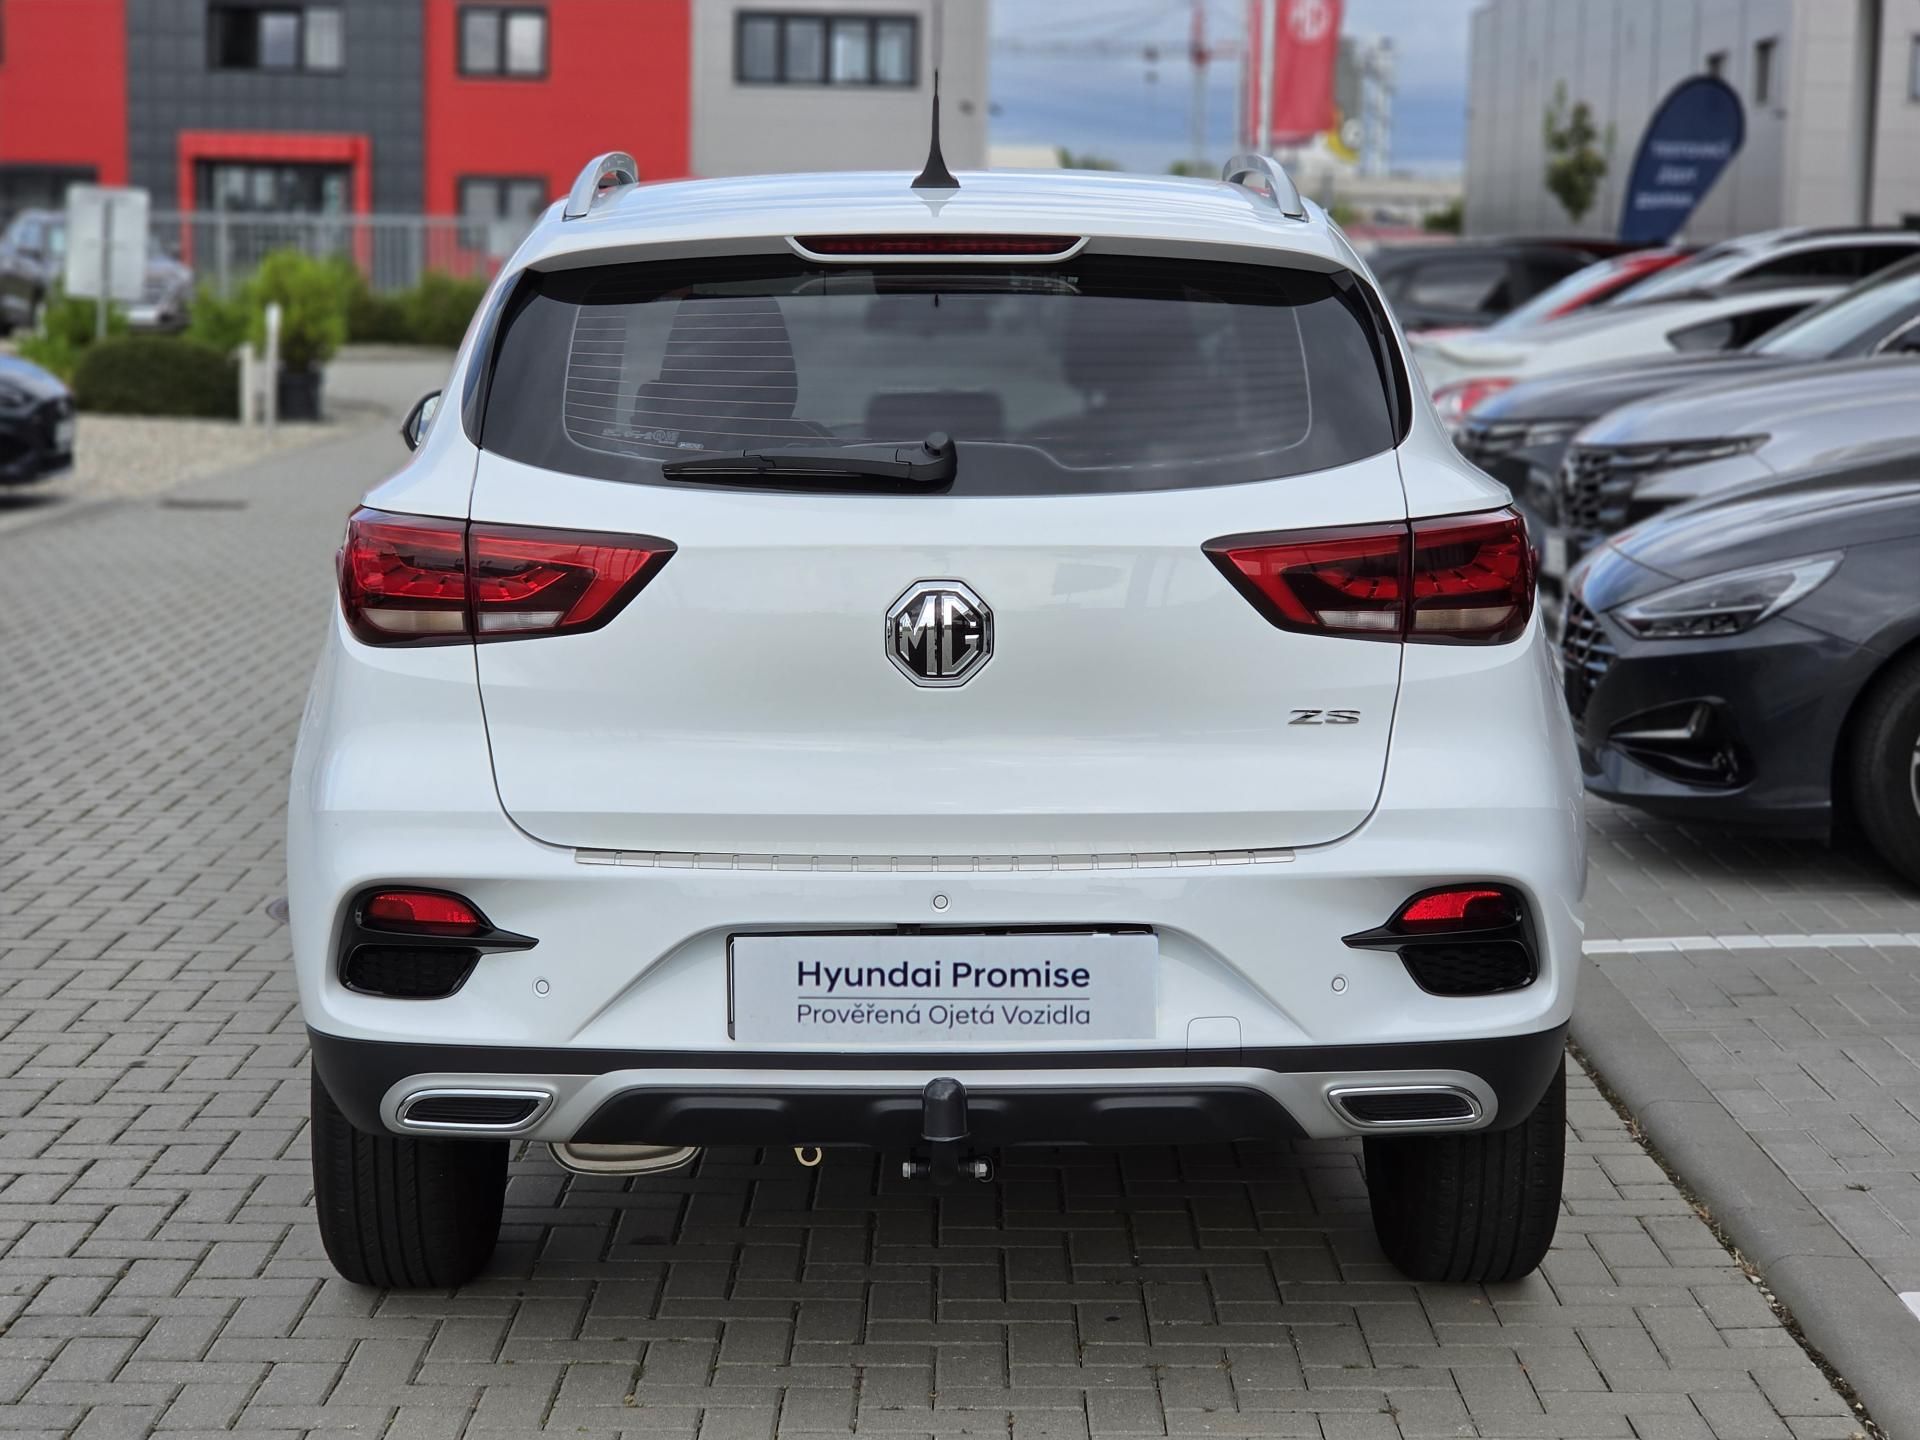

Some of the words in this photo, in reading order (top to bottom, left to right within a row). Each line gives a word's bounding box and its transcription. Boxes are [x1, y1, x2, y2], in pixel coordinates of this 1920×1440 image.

[897, 593, 981, 677] MG
[1287, 709, 1361, 725] ZS
[797, 959, 941, 994] Hyundai
[952, 960, 1091, 988] Promise
[797, 1003, 921, 1025] Prověřená
[928, 1003, 995, 1030] Ojetá
[1001, 1004, 1091, 1025] Vozidla
